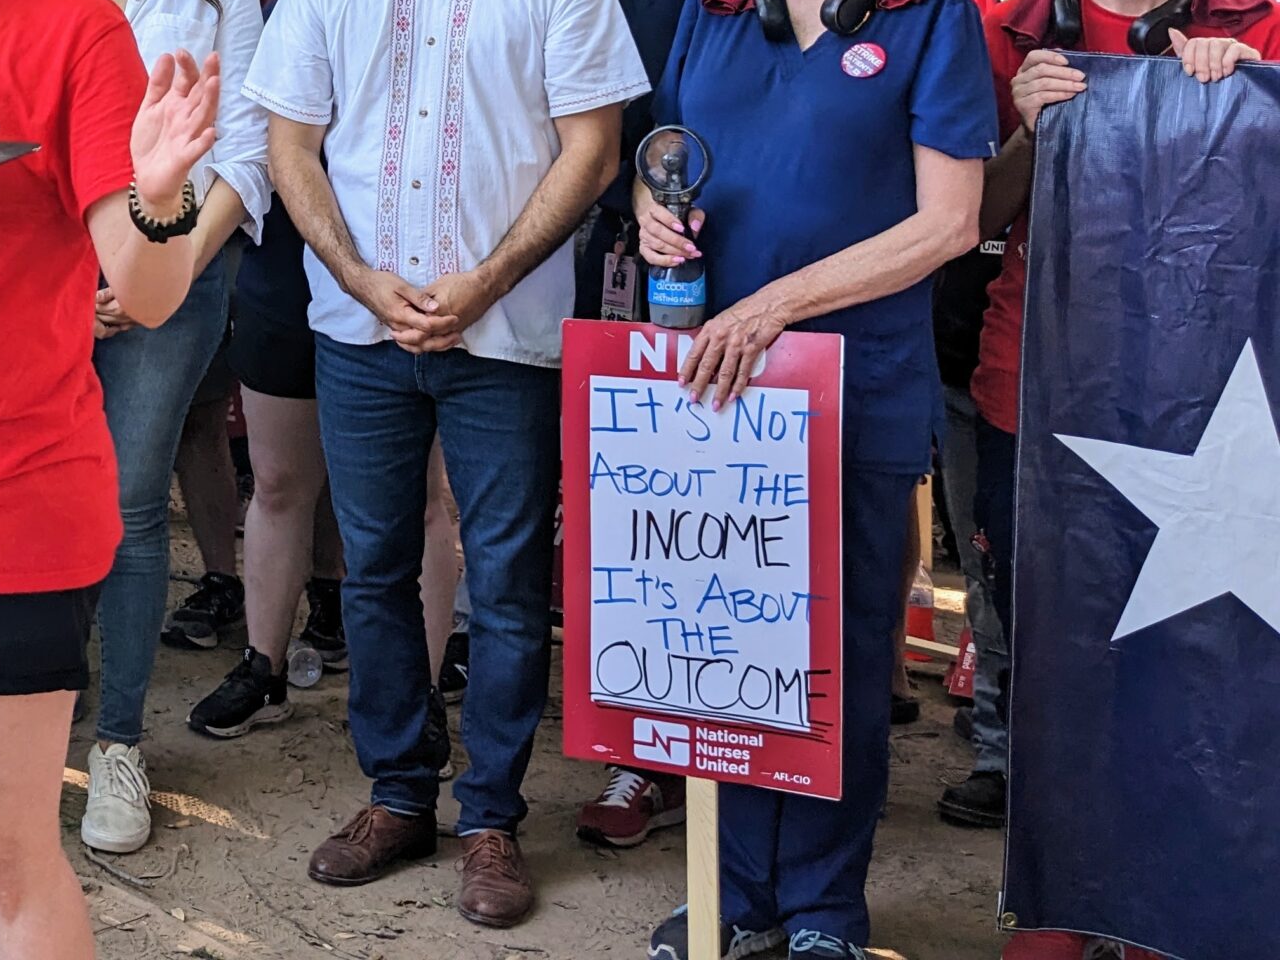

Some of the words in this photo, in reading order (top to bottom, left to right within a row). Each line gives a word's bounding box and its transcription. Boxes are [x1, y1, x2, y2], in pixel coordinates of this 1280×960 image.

[589, 451, 716, 497] ABOUT
[726, 462, 810, 507] THE
[630, 508, 790, 568] INCOME
[696, 572, 829, 625] ABOUT
[646, 617, 739, 656] THE
[596, 640, 834, 727] OUTCOME
[696, 726, 764, 748] National
[696, 743, 751, 761] Nurses
[696, 757, 750, 776] United
[773, 771, 812, 785] AFL-CIO
